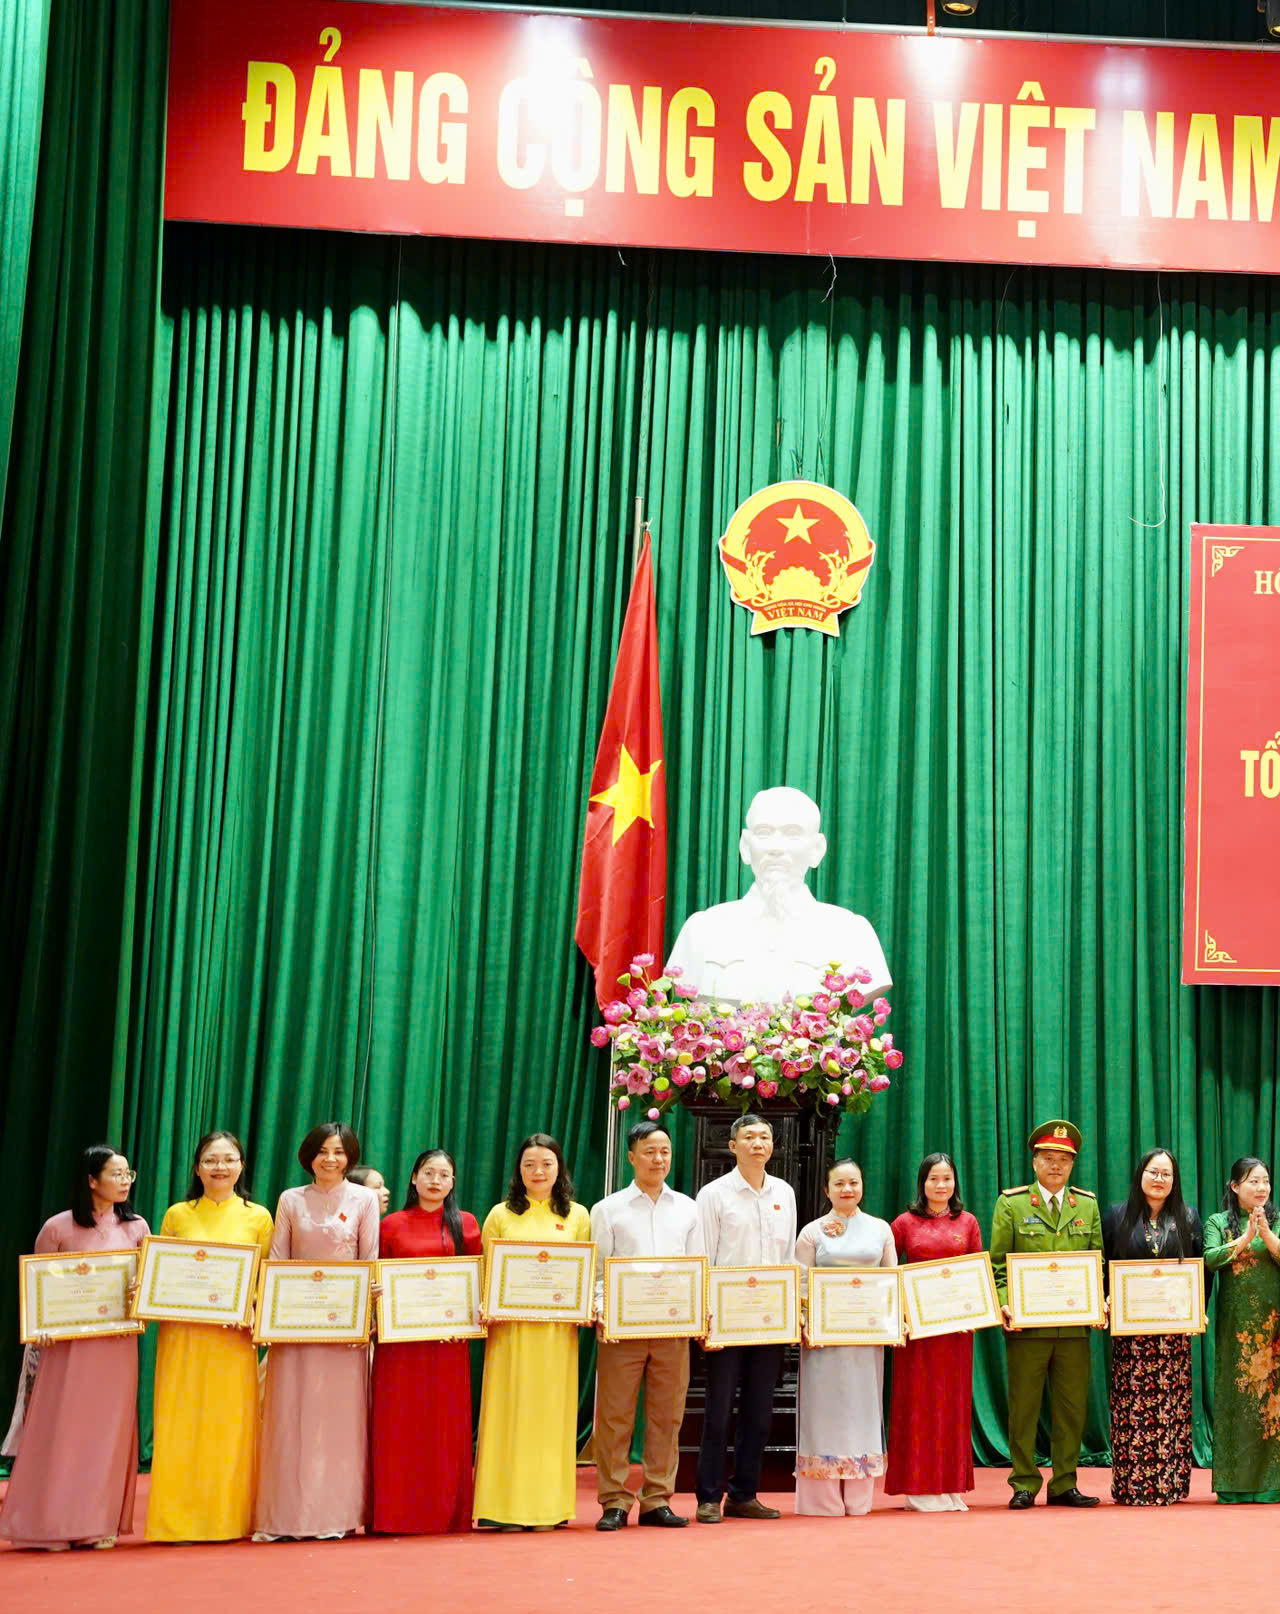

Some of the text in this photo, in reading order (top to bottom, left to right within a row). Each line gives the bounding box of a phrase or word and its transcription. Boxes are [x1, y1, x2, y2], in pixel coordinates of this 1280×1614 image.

[242, 25, 468, 185] ĐẢNG
[496, 56, 716, 217] CỘNG
[742, 56, 906, 206] SẢN
[933, 80, 1097, 239] VIỆT
[798, 607, 823, 621] NAM
